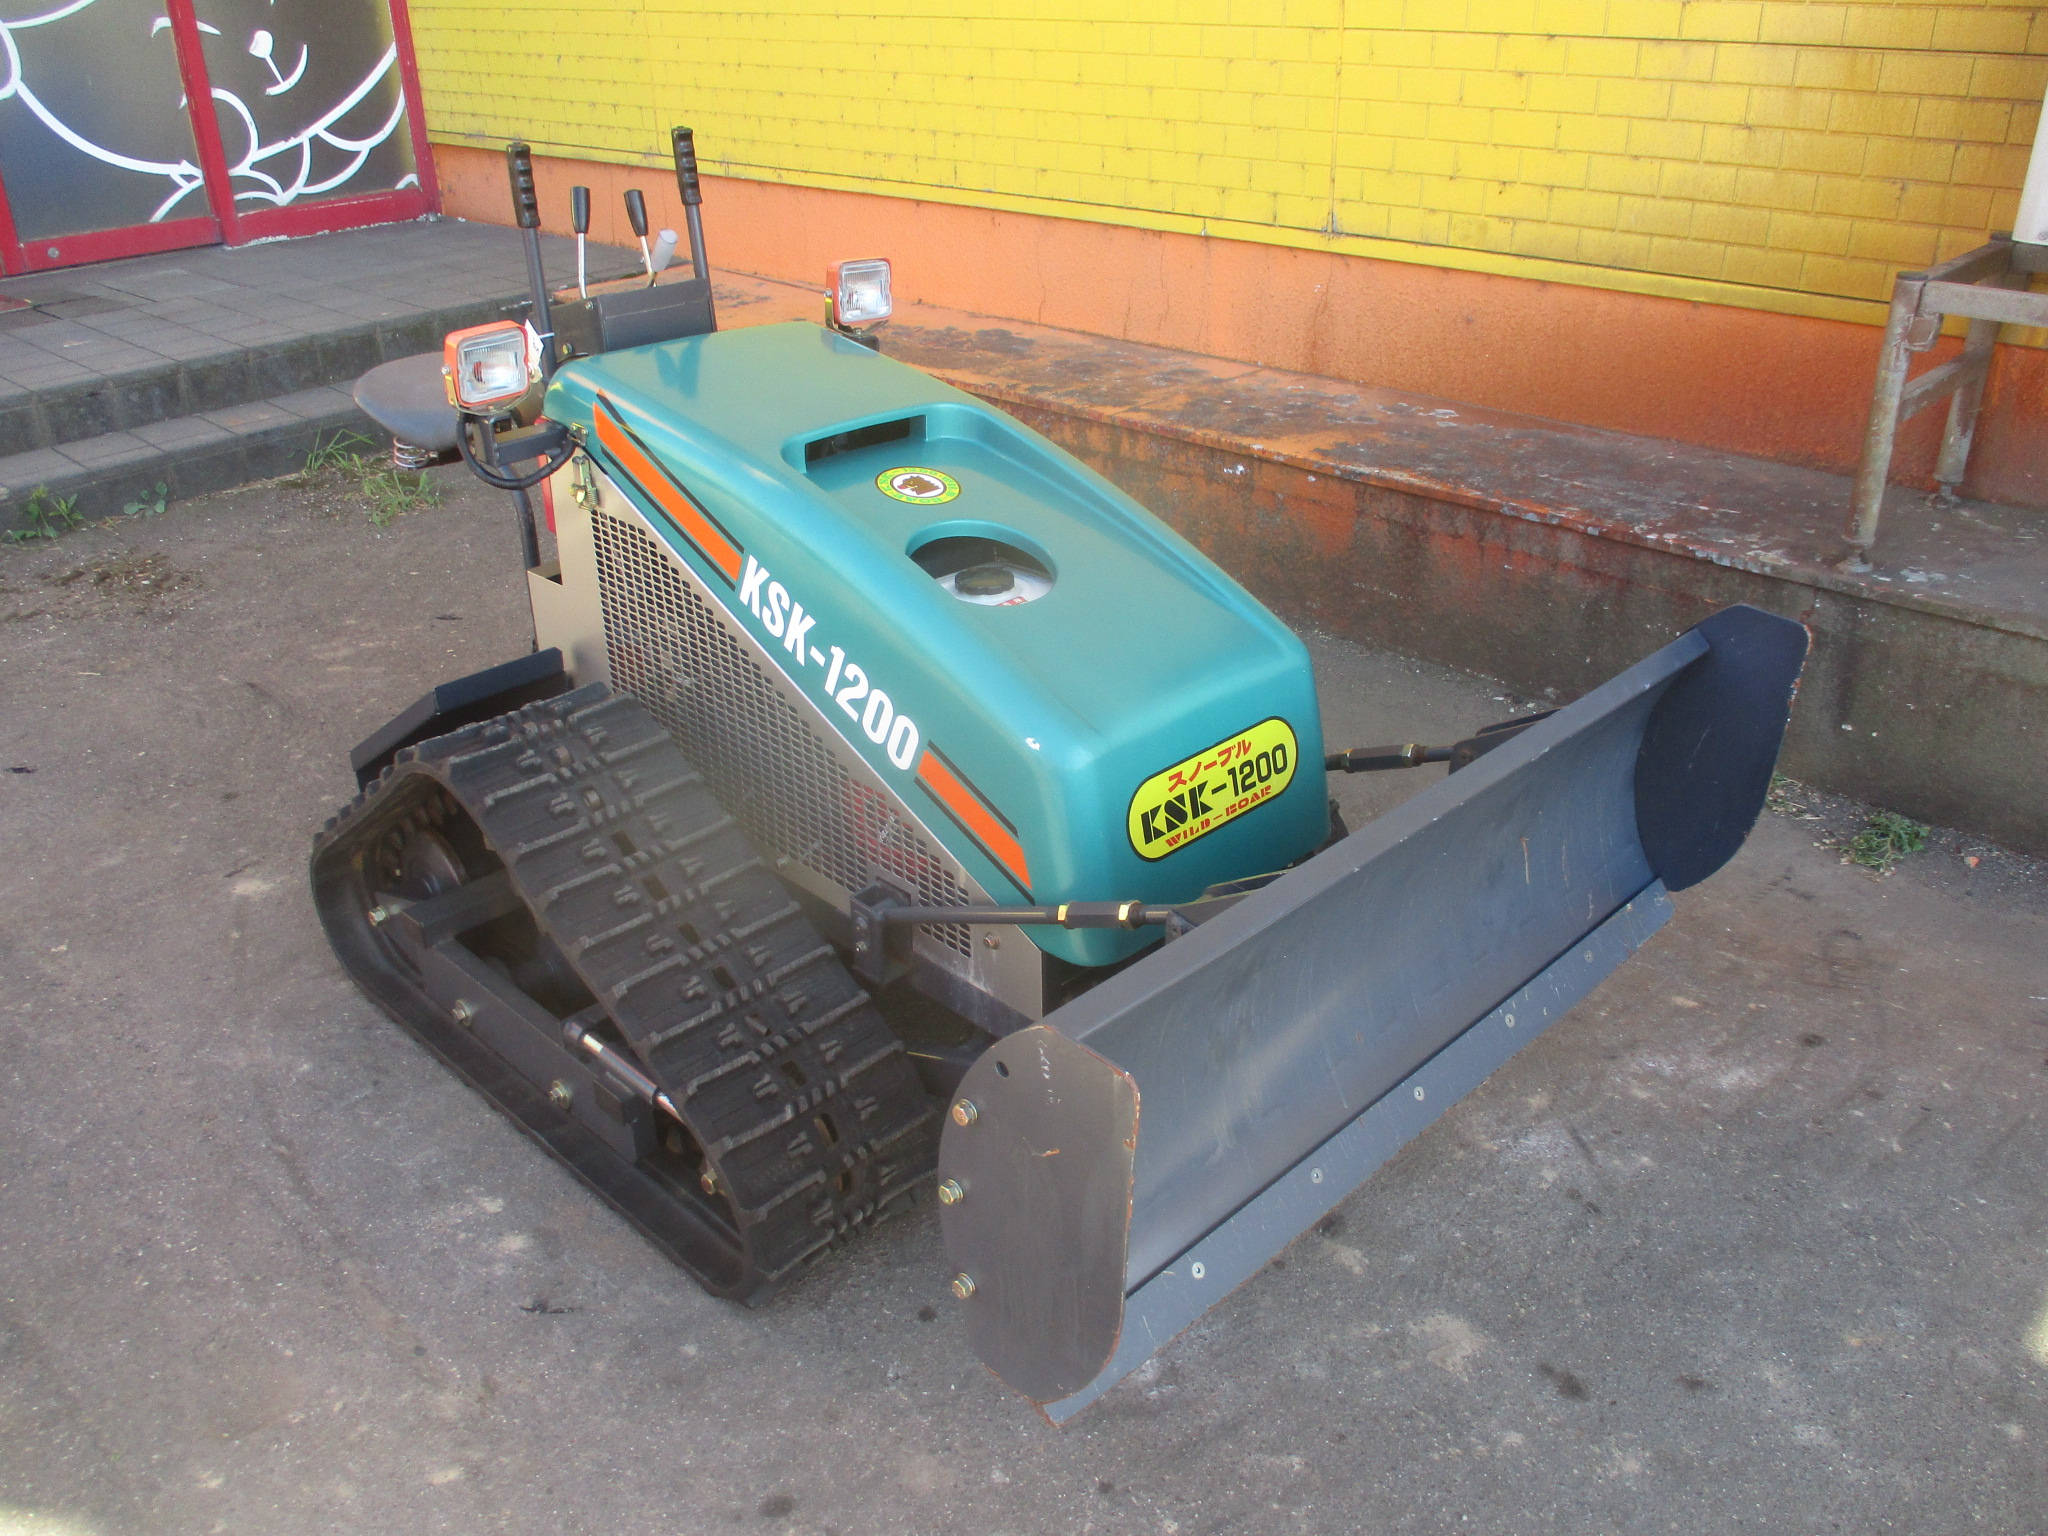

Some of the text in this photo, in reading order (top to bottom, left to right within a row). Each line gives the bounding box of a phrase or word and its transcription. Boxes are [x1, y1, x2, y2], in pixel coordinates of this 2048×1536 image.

[739, 554, 919, 771] KSK-1200
[1140, 743, 1288, 845] KSK-1200
[1167, 739, 1252, 793] スノーブル
